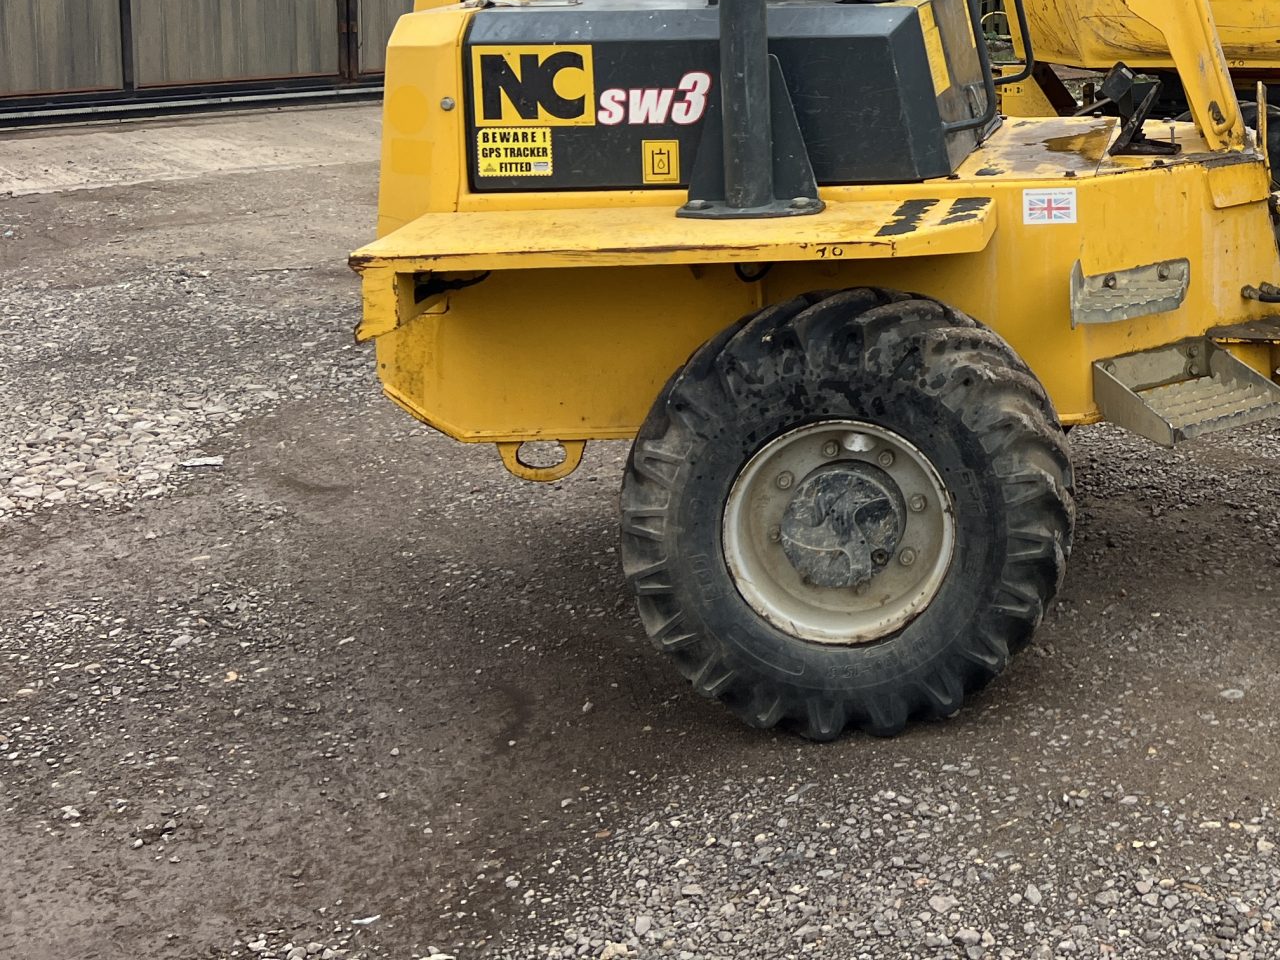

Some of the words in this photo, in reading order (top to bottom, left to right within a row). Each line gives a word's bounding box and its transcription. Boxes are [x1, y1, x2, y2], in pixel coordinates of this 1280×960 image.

[480, 51, 585, 120] NC
[482, 131, 537, 143] BEWARE
[482, 147, 502, 158] GPS
[503, 147, 548, 158] TRACKER
[499, 162, 532, 172] FITTED
